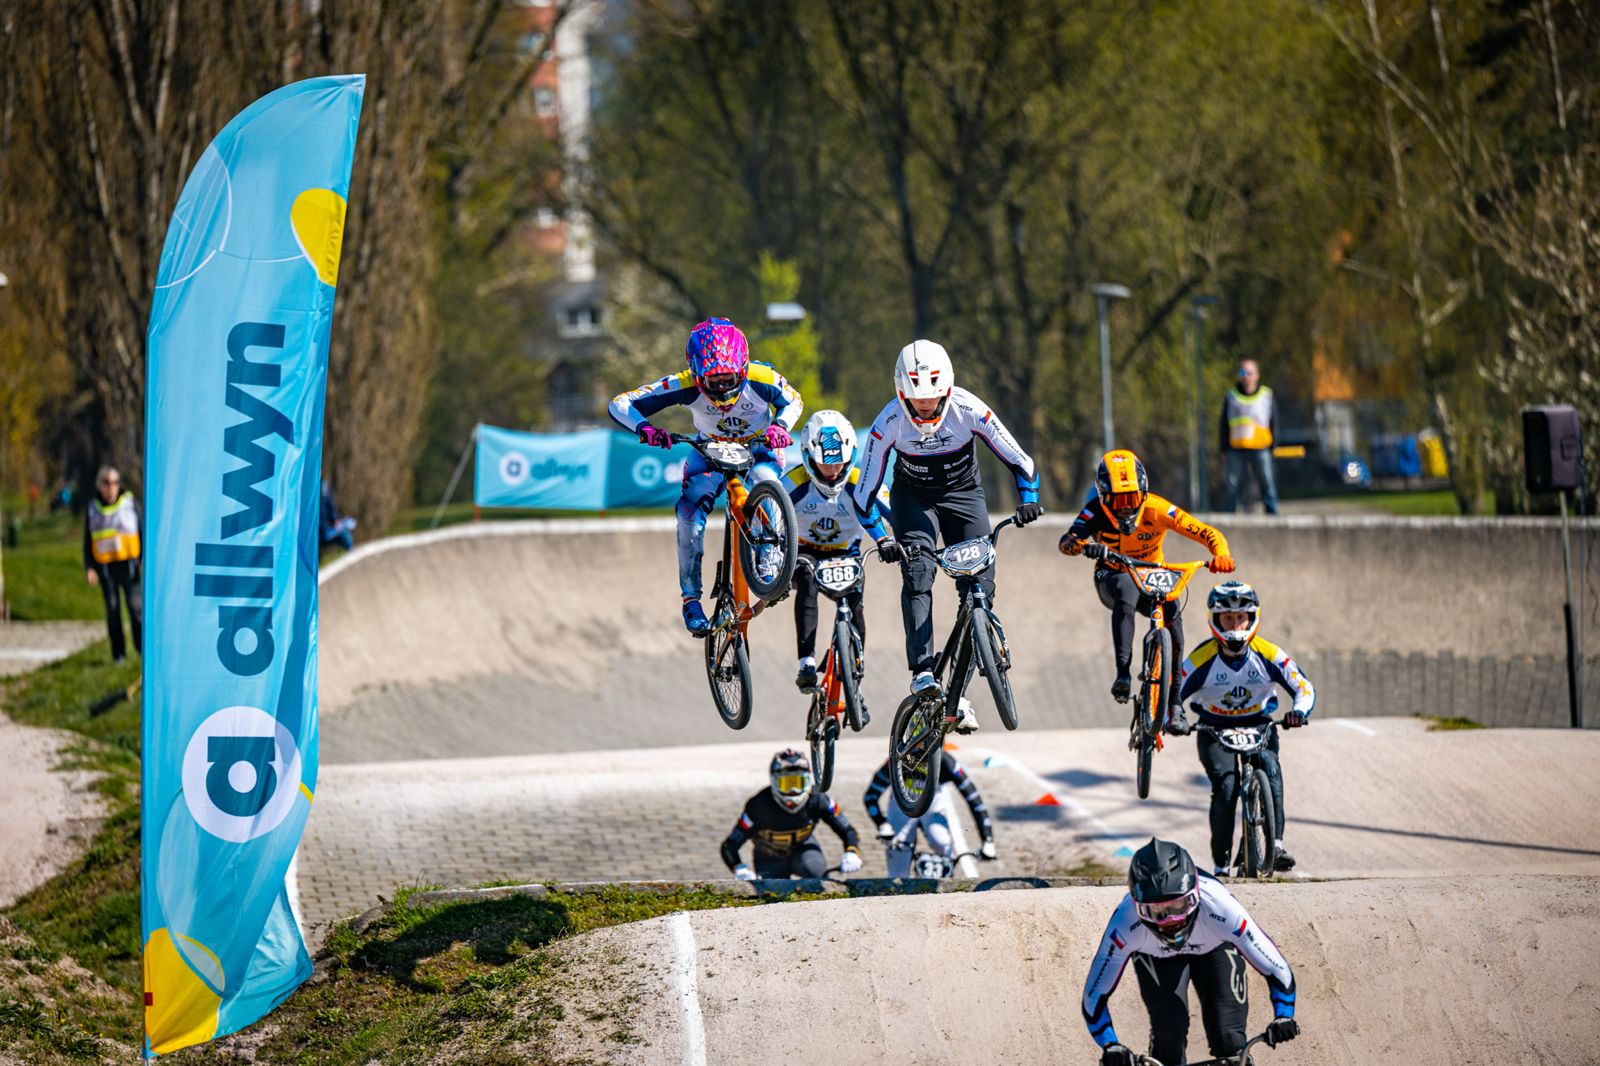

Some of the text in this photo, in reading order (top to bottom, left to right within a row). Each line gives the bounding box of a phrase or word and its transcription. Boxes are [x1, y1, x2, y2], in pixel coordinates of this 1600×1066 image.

[193, 321, 294, 677] allwyn
[953, 546, 981, 563] 128
[822, 566, 855, 583] 868
[1149, 572, 1173, 586] 421
[1229, 734, 1256, 745] 101
